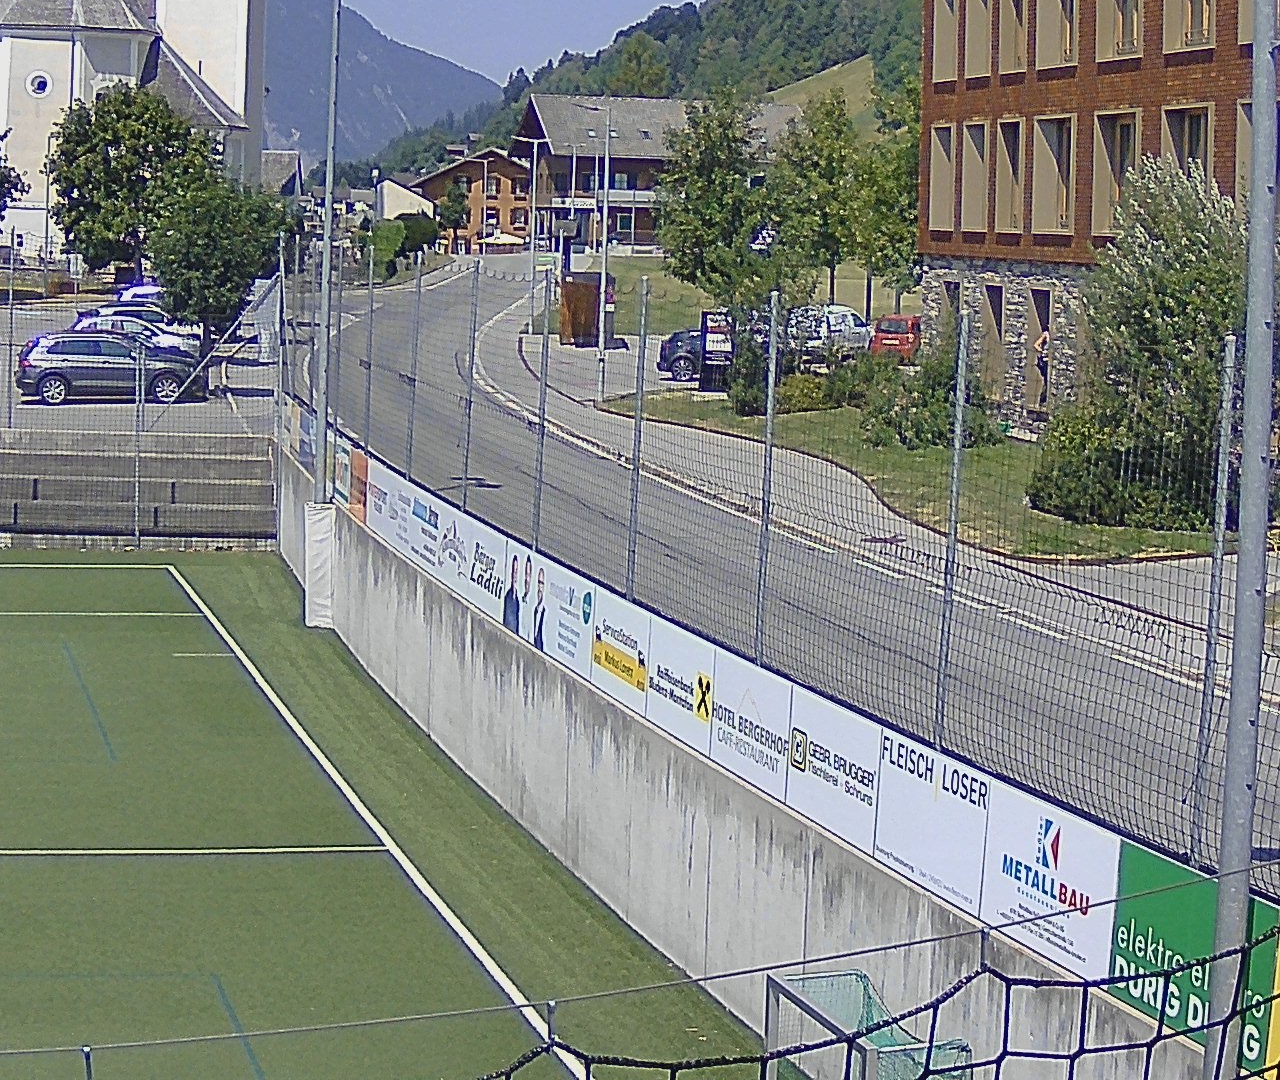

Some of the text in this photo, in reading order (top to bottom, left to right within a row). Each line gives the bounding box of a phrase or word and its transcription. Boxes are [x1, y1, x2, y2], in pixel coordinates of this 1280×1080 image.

[657, 664, 695, 697] Raiffeisenbank
[712, 700, 790, 757] HOTEL BERGERHOF
[808, 740, 875, 791] GEBR. BRUGGER
[808, 759, 874, 807] Tischlerei Schruns
[881, 735, 989, 810] FLEISCH LOSER
[1002, 854, 1090, 916] METALLBAU
[1117, 918, 1185, 977] elektro
